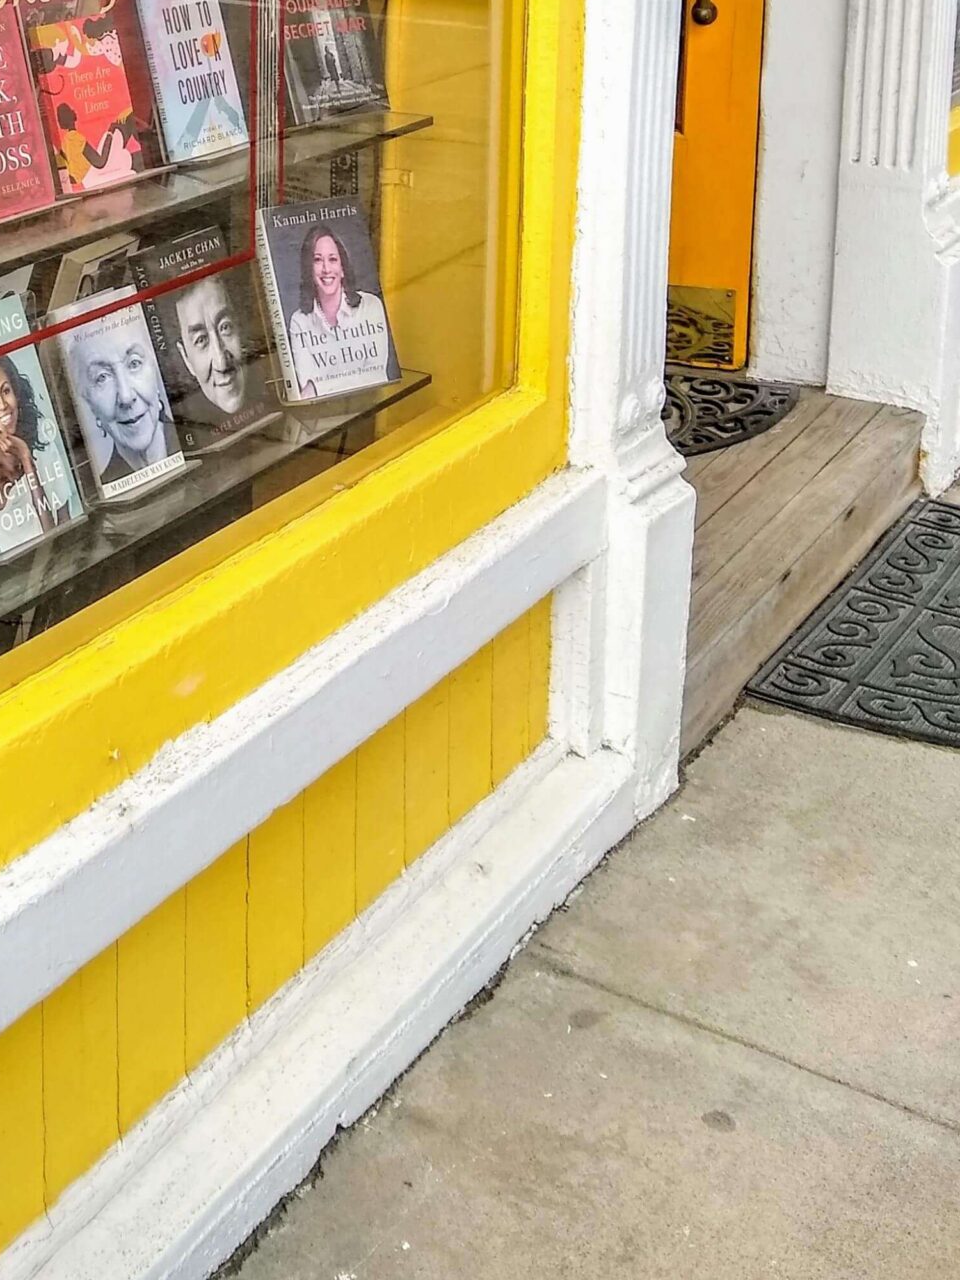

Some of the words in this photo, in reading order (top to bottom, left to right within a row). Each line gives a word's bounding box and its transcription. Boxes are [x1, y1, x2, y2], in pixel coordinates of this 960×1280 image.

[162, 3, 190, 36] HOW
[195, 0, 212, 27] TO
[283, 23, 331, 41] SECRET
[169, 40, 202, 71] LOVE
[211, 34, 221, 61] A
[68, 70, 94, 84] There
[95, 67, 111, 80] Are
[177, 70, 228, 105] COUNTRY
[73, 86, 95, 100] Girls
[84, 100, 109, 114] Lions
[183, 134, 217, 150] RICHARD
[217, 127, 243, 144] BLANCO
[1, 177, 41, 194] SELZNICK
[272, 212, 317, 228] Kamala
[319, 204, 358, 221] Harris
[159, 246, 194, 270] JACKIE
[195, 236, 221, 258] CHAN
[295, 329, 328, 349] The
[330, 318, 385, 342] Truths
[312, 351, 338, 370] We
[341, 341, 378, 365] Hold
[110, 471, 150, 492] MADELEINE
[163, 454, 183, 470] KUNIN
[0, 490, 64, 532] OBAMA
